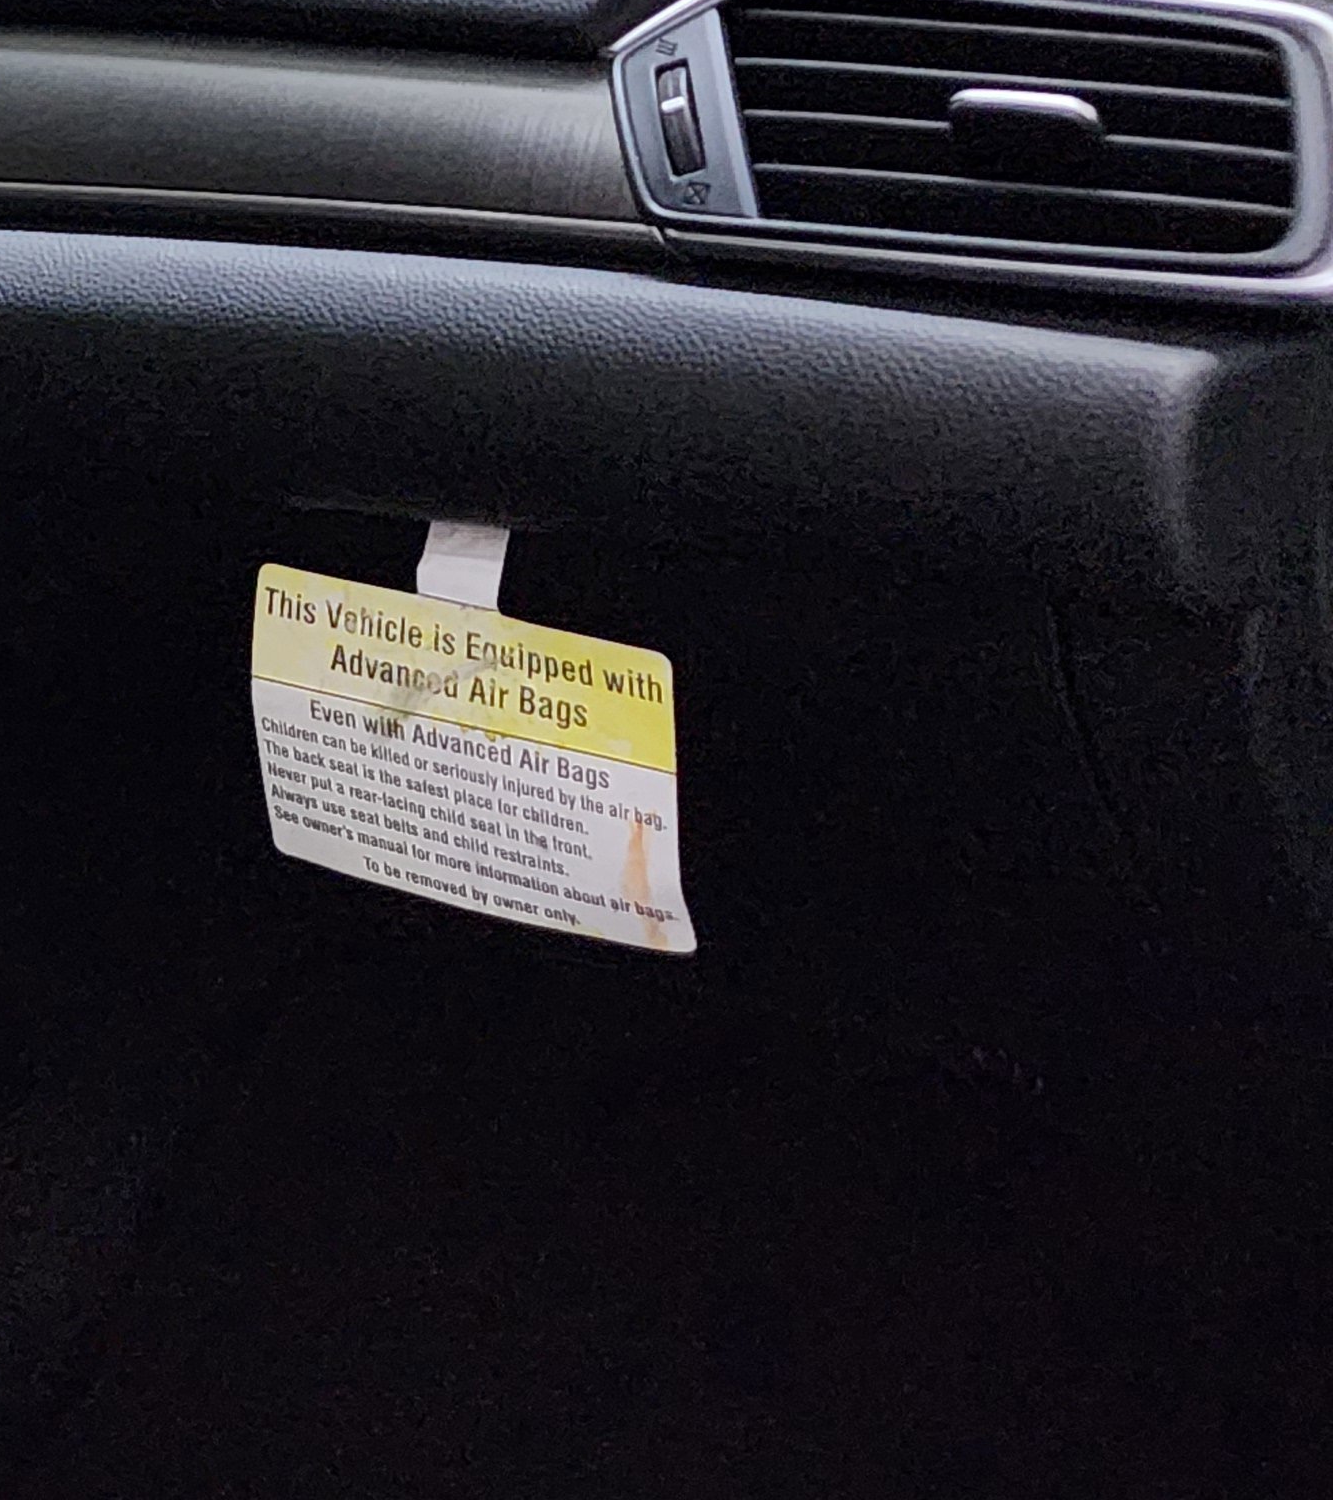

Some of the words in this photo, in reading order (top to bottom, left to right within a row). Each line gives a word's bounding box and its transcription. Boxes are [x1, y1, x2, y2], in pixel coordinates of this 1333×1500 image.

[264, 587, 316, 624] This
[326, 599, 422, 648] Vehicle
[434, 624, 456, 655] is
[466, 631, 593, 687] Equipped
[603, 668, 663, 704] with
[331, 644, 458, 699] Advanced
[469, 676, 509, 709] Air
[520, 686, 588, 730] Bags
[261, 716, 318, 744] Children
[322, 734, 346, 751] can
[350, 738, 367, 756] be
[371, 743, 410, 766] killed
[414, 757, 428, 771] or
[433, 761, 498, 792] seriously
[503, 774, 554, 802] injured
[558, 788, 576, 811] by
[580, 795, 604, 815] the
[609, 803, 630, 821] air
[634, 806, 668, 832] bag.
[263, 738, 289, 758] The
[293, 747, 326, 768] back
[329, 760, 359, 777] seat
[363, 763, 375, 781] is
[379, 769, 401, 787] the
[406, 777, 450, 800] safest
[454, 788, 493, 811] place
[498, 798, 518, 817] for
[522, 806, 590, 835] children.
[309, 699, 356, 729] Even
[362, 715, 405, 741] with
[412, 724, 511, 766] Advanced
[519, 749, 550, 774] Air
[558, 757, 610, 790] Bags
[267, 761, 306, 785] Never
[311, 775, 333, 792] put
[336, 783, 345, 795] a
[349, 786, 426, 819] rear-facing
[430, 805, 466, 827] child
[470, 816, 502, 837] seat
[505, 822, 520, 842] in
[524, 828, 548, 850] the
[552, 835, 592, 860] front.
[271, 783, 318, 810] Always
[322, 800, 346, 817] use
[350, 808, 380, 827] seat
[384, 817, 418, 837] belts
[423, 827, 449, 845] and
[454, 835, 489, 855] child
[494, 845, 570, 876] restraints.
[273, 804, 299, 824] See
[302, 816, 354, 841] owner's
[357, 832, 408, 856] manual
[412, 843, 431, 862] for
[435, 853, 471, 873] more
[476, 861, 559, 896] information
[563, 886, 606, 907] about
[610, 898, 631, 913] air
[634, 901, 680, 922] bags.
[363, 856, 380, 873] To
[384, 861, 401, 878] be
[405, 870, 467, 898] removed
[472, 885, 488, 906] by
[493, 894, 539, 916] owner
[544, 906, 582, 926] only.
